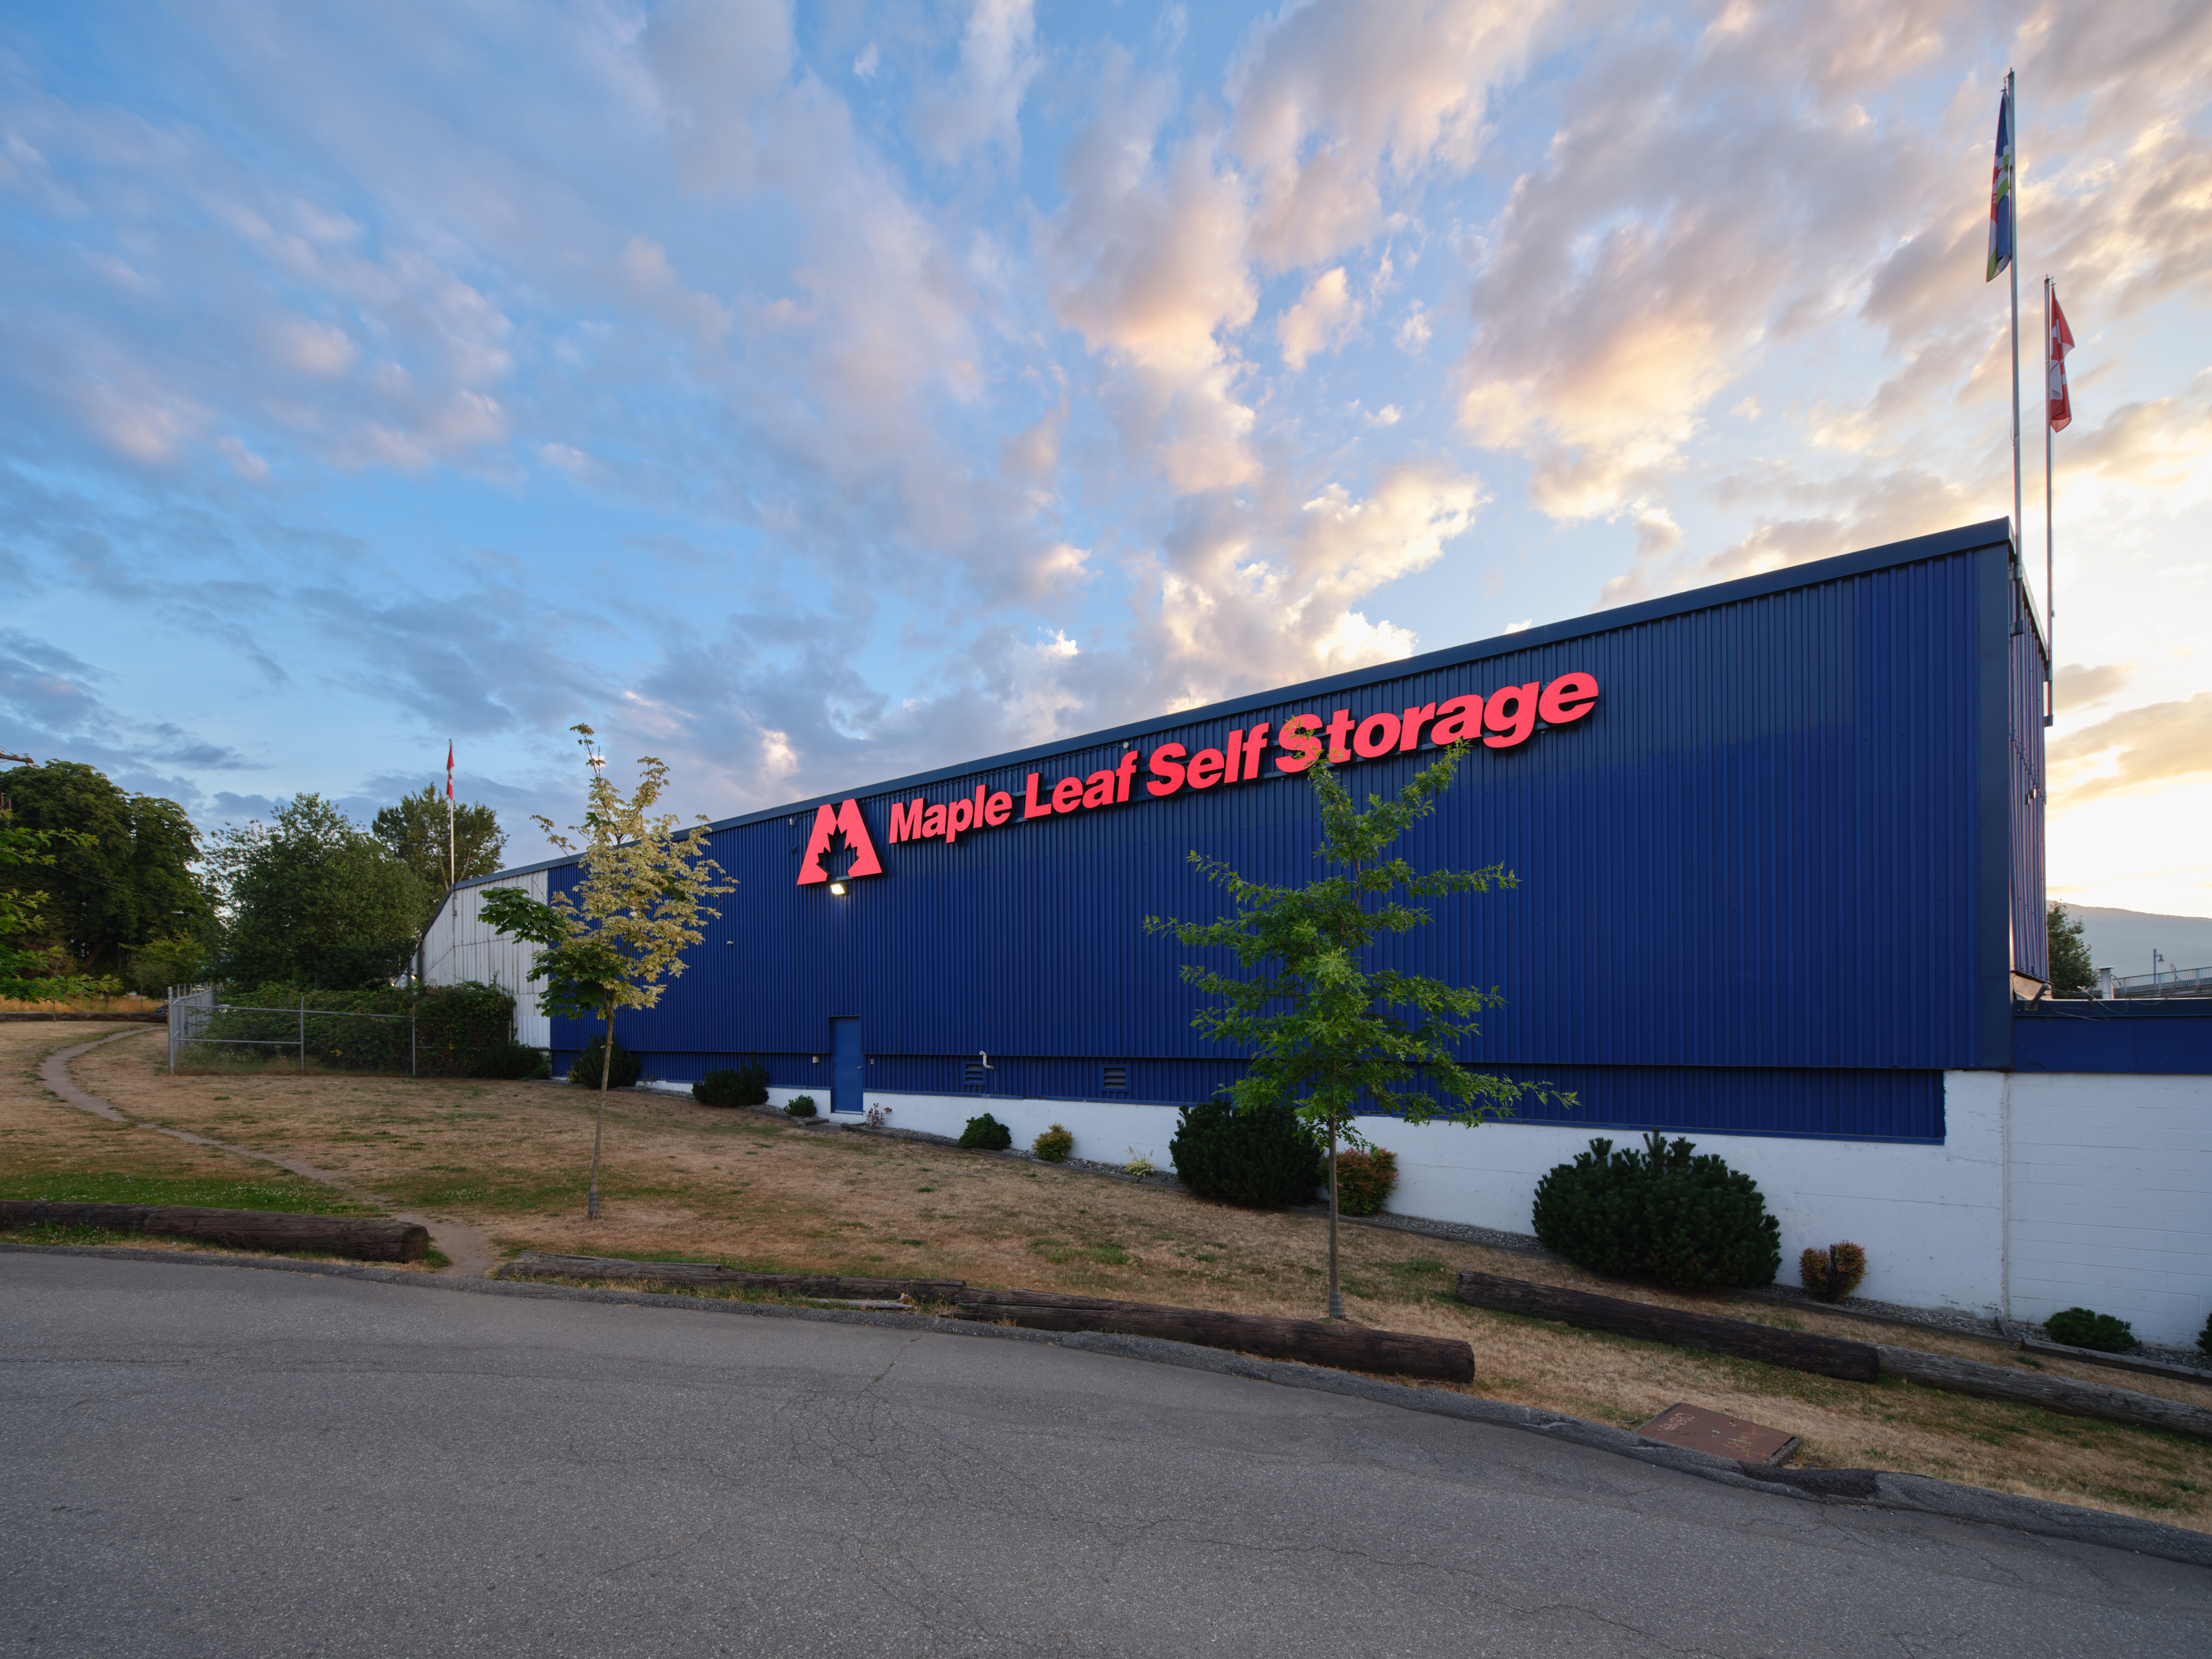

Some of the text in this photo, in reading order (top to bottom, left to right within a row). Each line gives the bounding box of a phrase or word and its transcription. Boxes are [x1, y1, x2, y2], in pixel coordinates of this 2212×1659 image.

[888, 672, 1599, 844] Maple Leaf Self Storage
